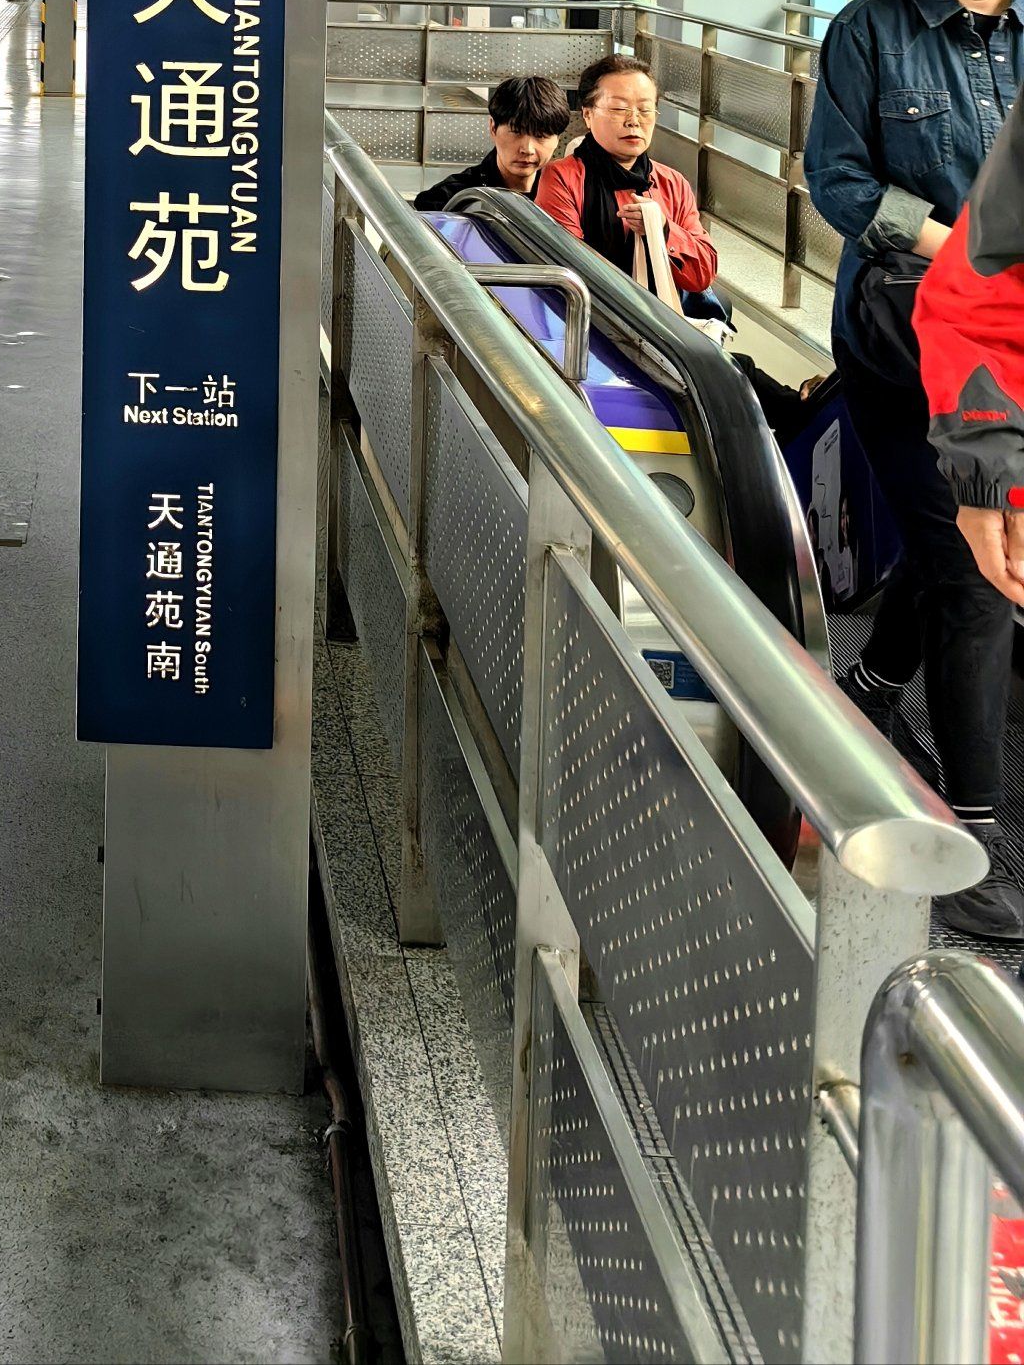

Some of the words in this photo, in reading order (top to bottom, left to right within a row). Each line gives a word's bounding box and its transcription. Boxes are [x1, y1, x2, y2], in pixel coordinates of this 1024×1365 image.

[123, 405, 169, 425] Next
[172, 407, 238, 427] Station
[127, 372, 237, 407] 下一站
[145, 492, 184, 680] 天通苑南
[194, 482, 214, 637] TIANTONGYUAN
[194, 640, 212, 694] South
